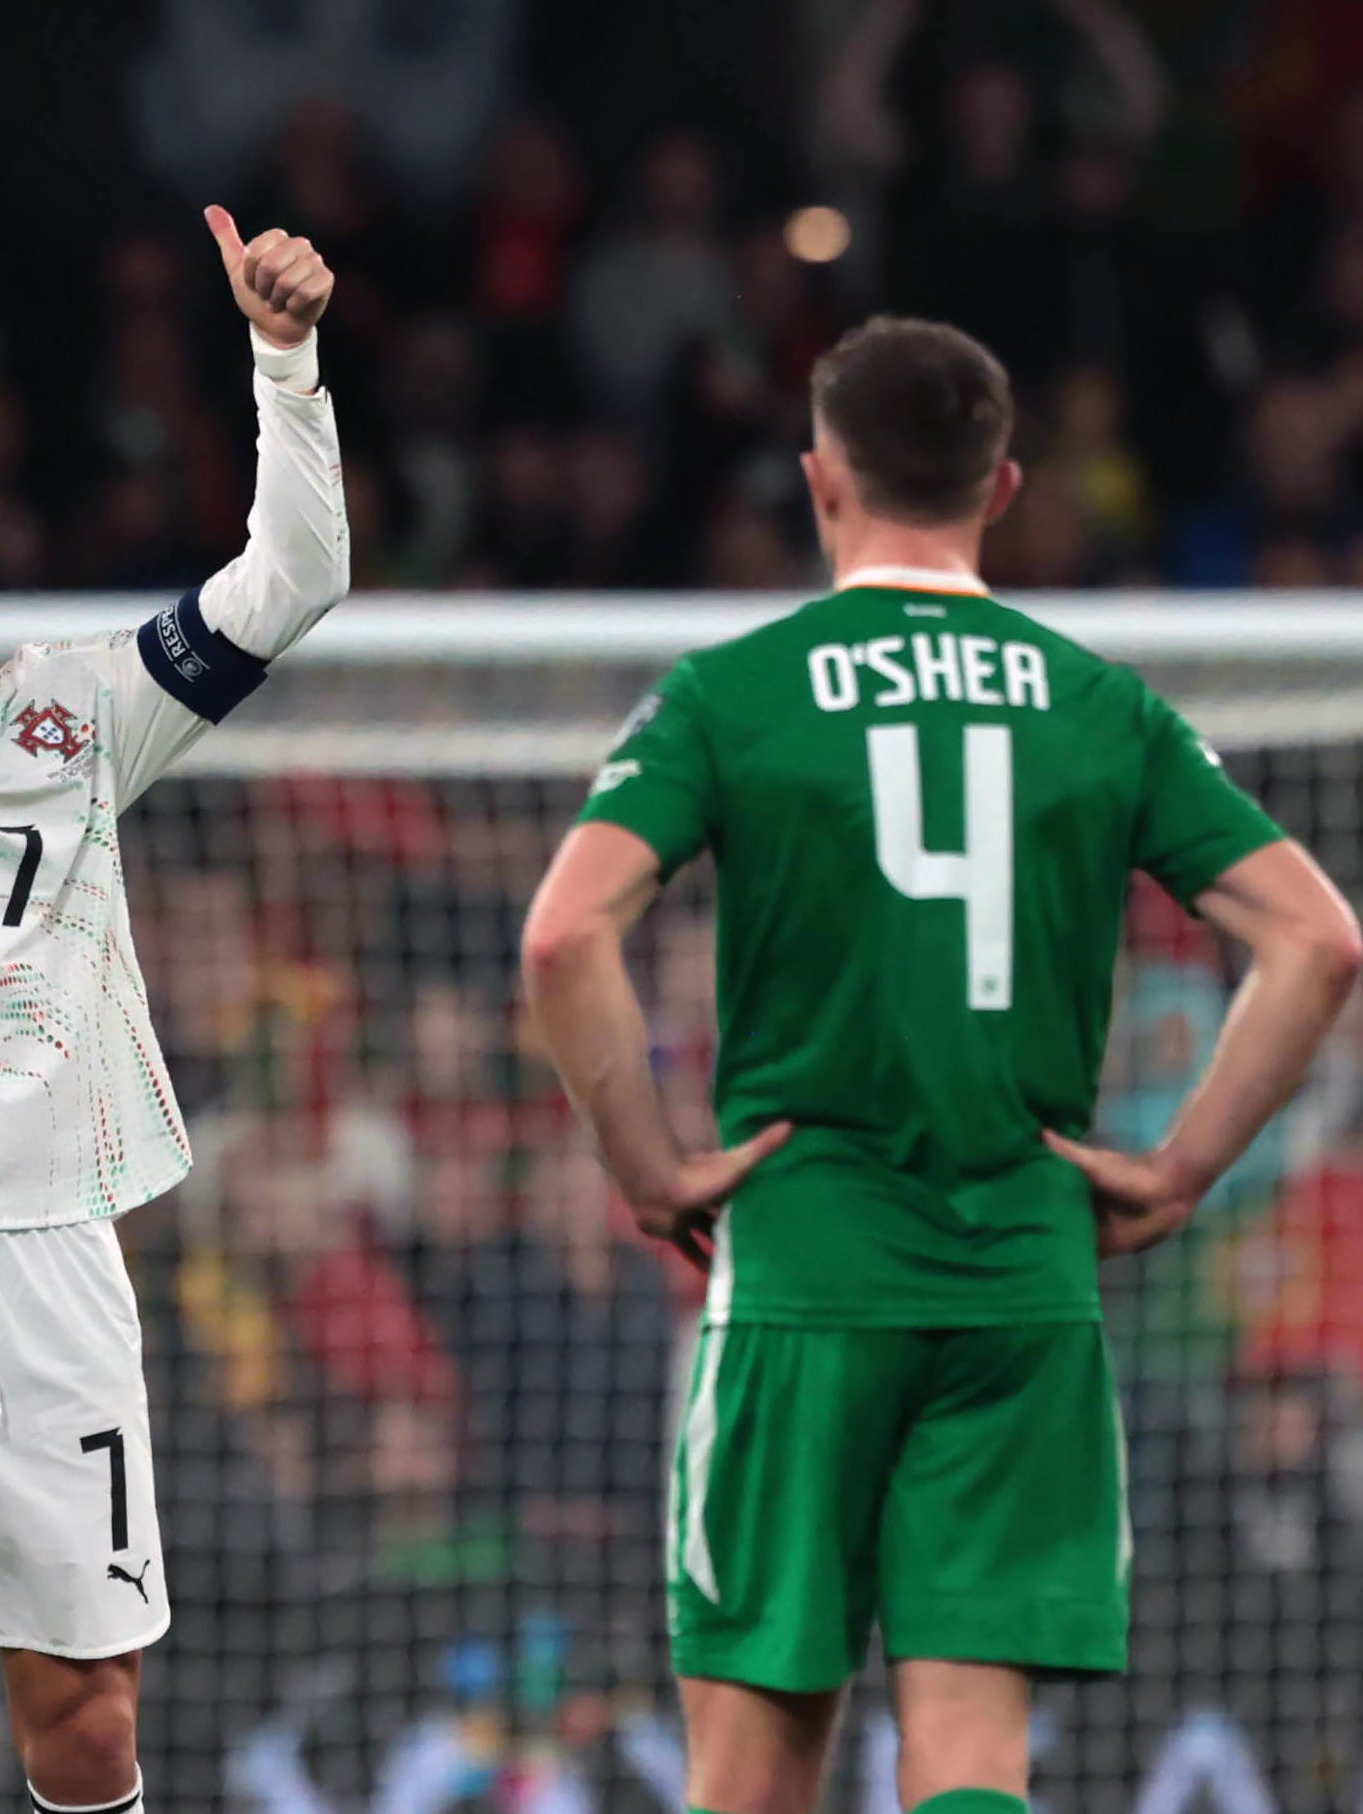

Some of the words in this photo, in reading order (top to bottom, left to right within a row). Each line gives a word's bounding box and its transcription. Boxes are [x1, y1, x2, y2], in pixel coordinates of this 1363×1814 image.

[807, 632, 1050, 712] O'SHEA
[867, 723, 1014, 1012] 4
[79, 1426, 129, 1552] 7
